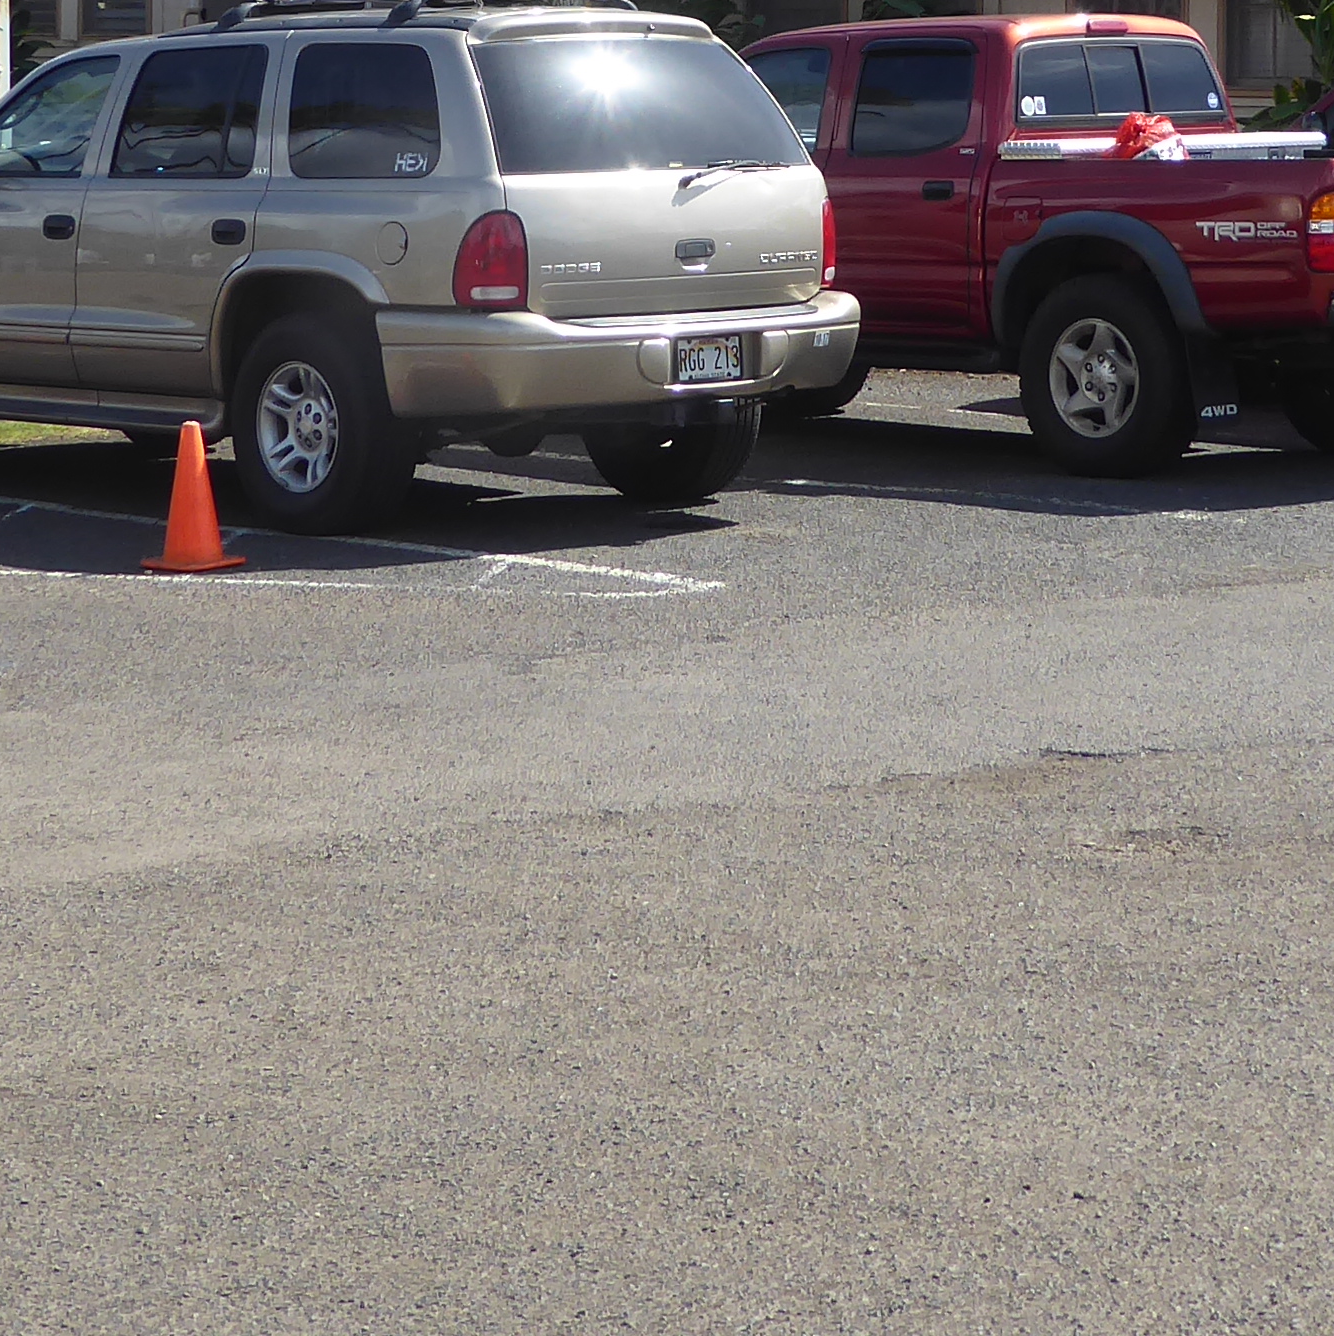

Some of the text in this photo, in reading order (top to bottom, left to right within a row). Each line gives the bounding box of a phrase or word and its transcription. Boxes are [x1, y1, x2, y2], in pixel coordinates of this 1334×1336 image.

[1195, 221, 1256, 241] TRD
[1257, 230, 1298, 238] ROAD
[540, 261, 602, 275] DODGE
[678, 345, 740, 373] RGG 213
[1200, 403, 1238, 418] 4WD
